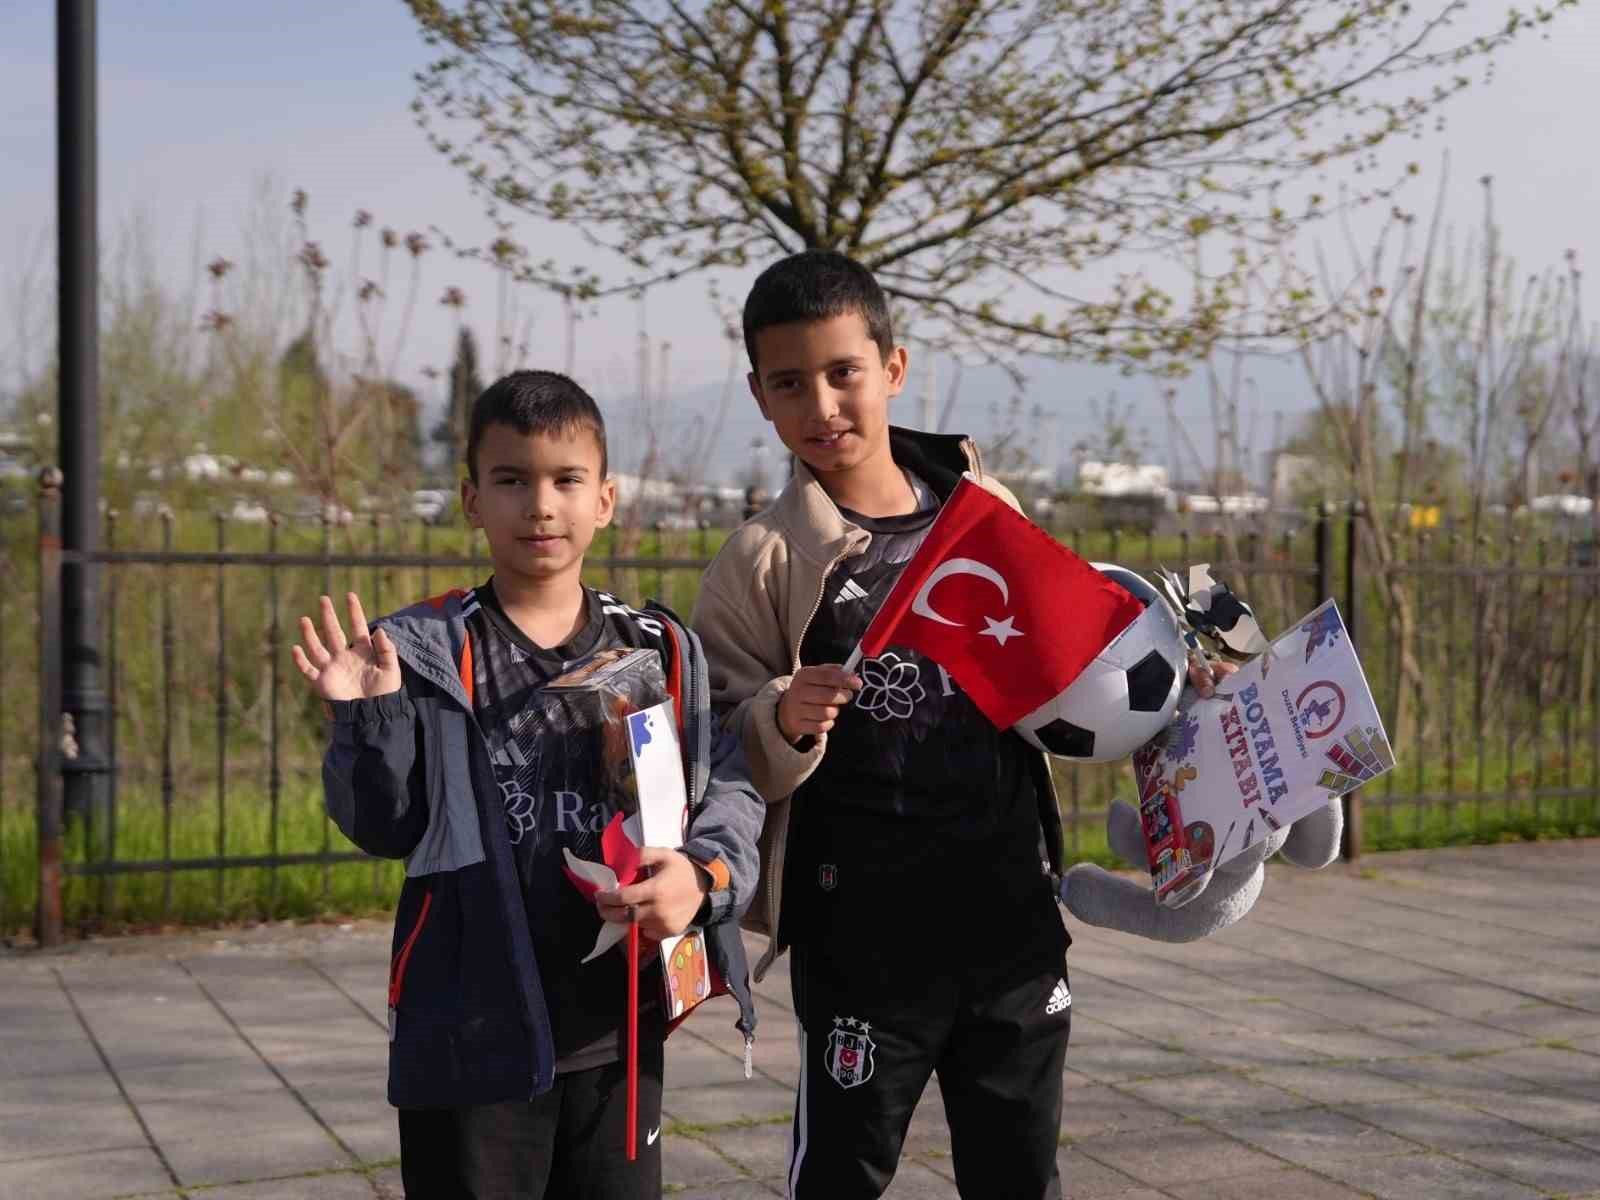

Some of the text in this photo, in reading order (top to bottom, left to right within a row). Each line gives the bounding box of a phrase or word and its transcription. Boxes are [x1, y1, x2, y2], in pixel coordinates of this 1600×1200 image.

[1219, 705, 1262, 808] KİTABI
[1238, 682, 1288, 805] BOYAMA
[553, 791, 610, 832] Ra
[1045, 994, 1072, 1015] adida
